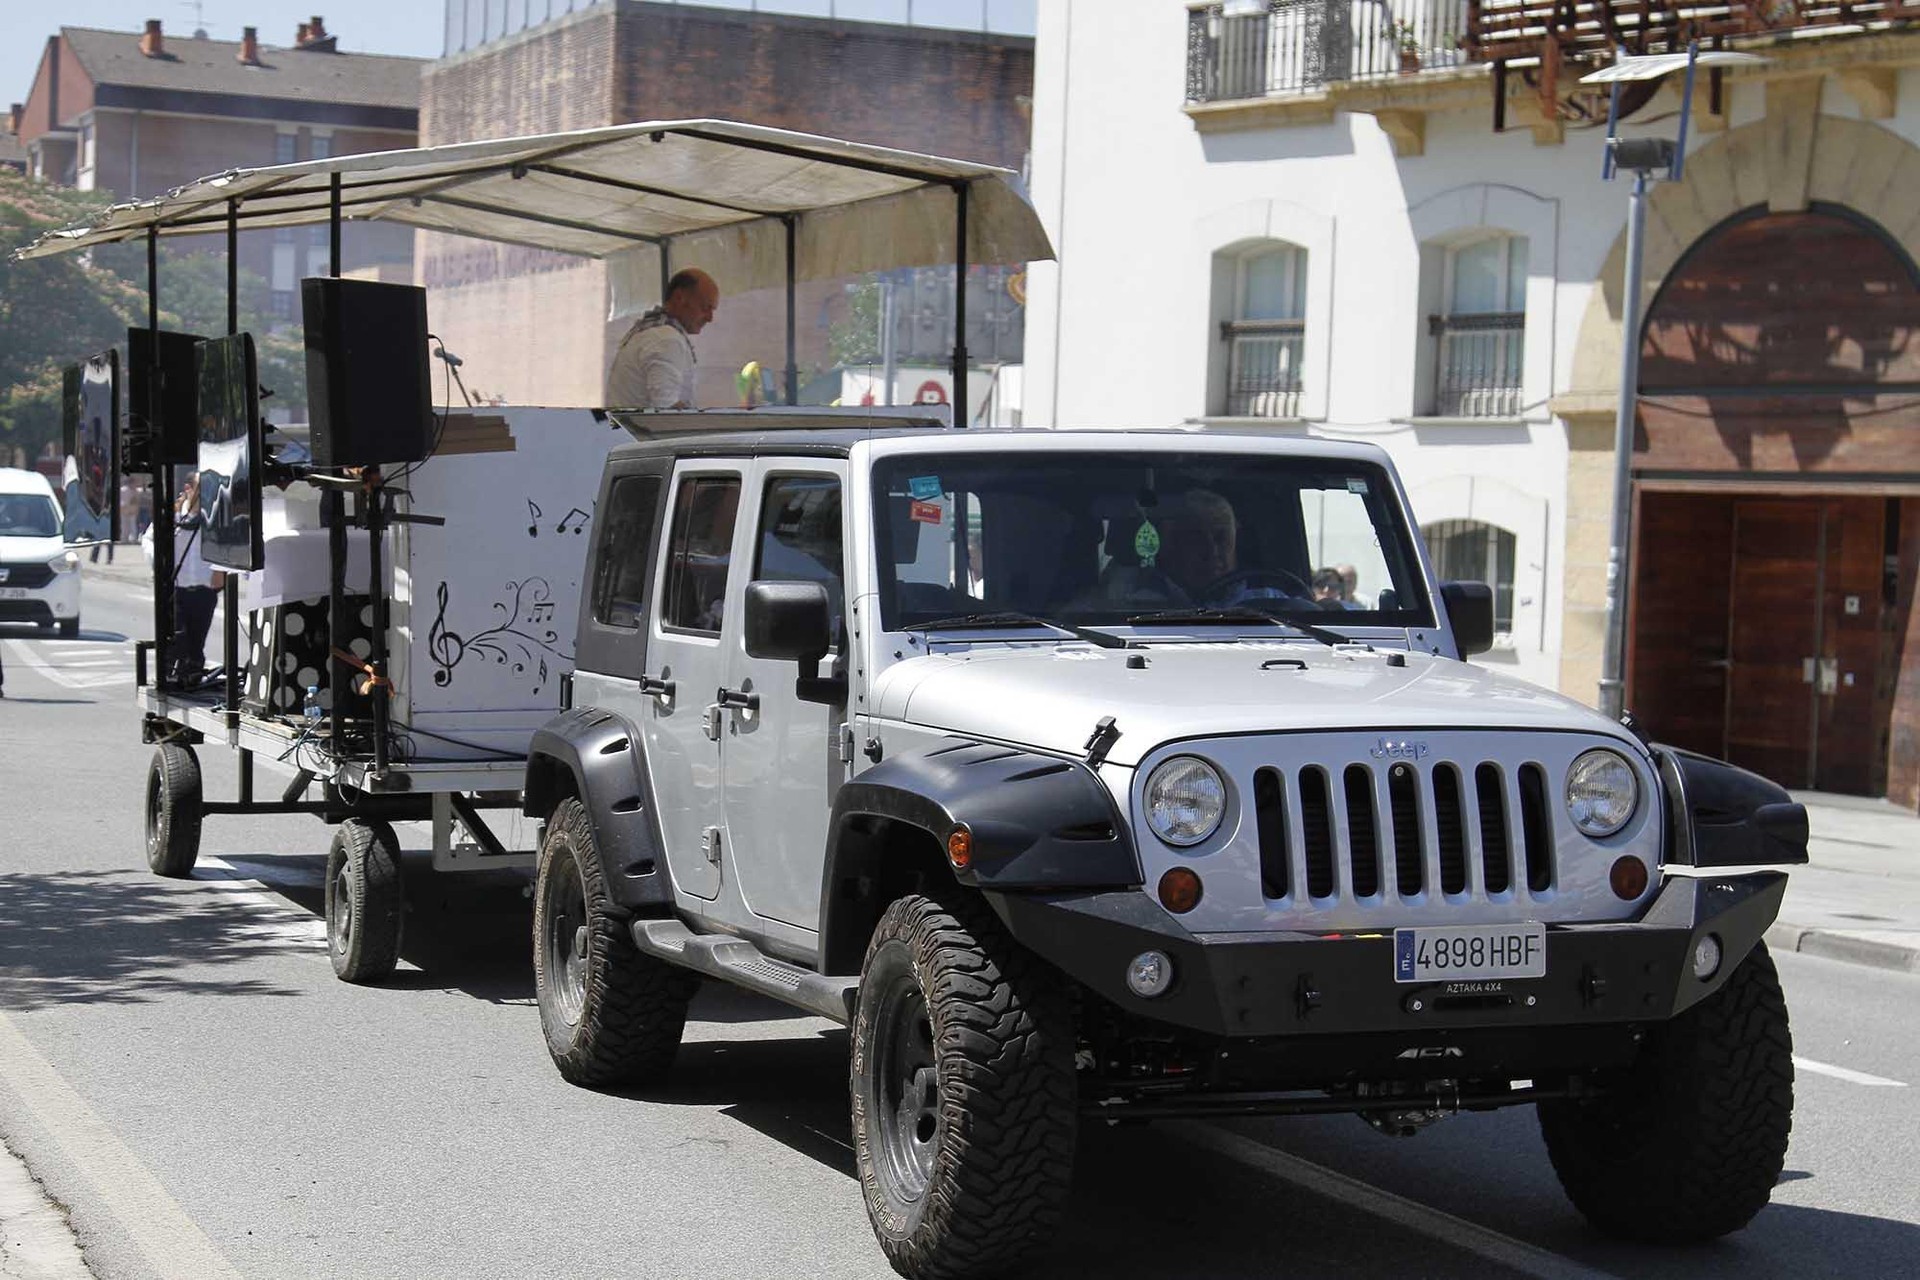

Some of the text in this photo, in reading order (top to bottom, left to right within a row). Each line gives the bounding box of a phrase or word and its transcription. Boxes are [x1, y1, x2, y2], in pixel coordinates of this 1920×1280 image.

[1370, 737, 1429, 760] Jeep
[1446, 982, 1501, 993] AZTAKA 4X4
